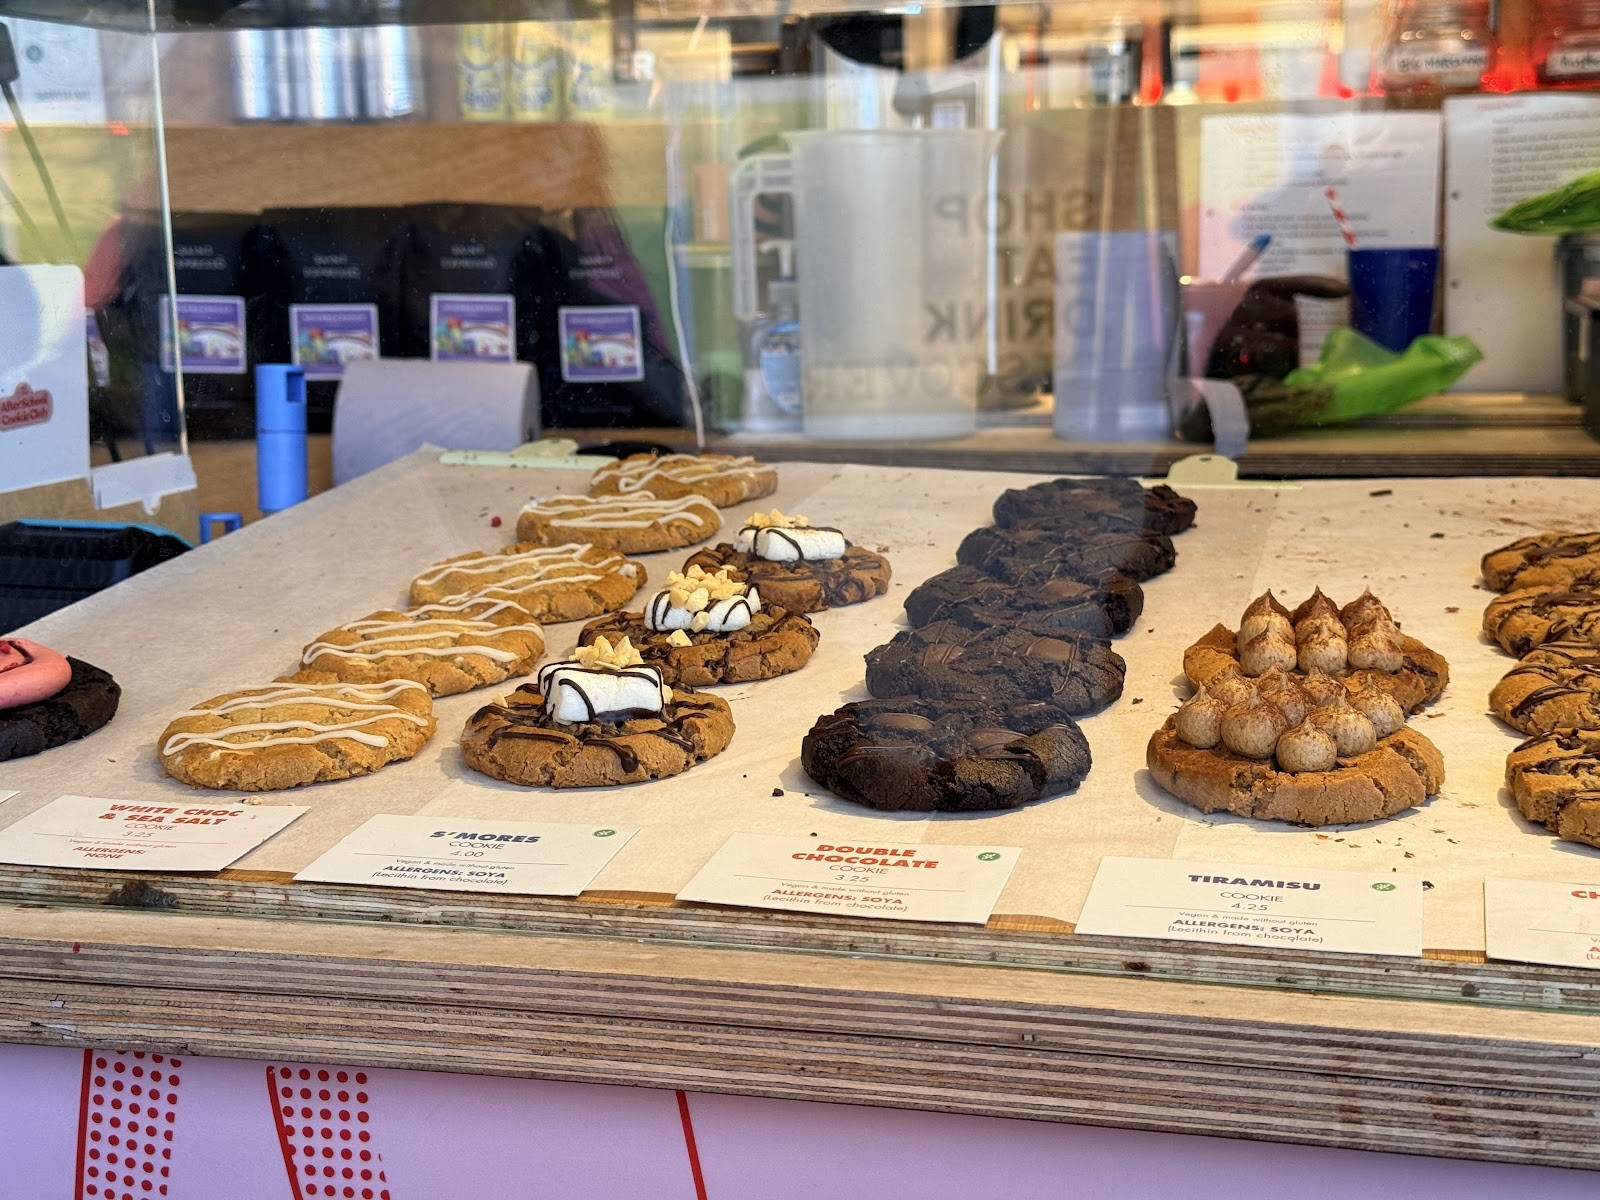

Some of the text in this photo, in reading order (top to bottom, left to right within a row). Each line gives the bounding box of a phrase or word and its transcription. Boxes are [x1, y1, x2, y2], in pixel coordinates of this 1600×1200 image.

[110, 805, 244, 817] WHITE CHOC
[123, 814, 165, 822] SEA
[171, 817, 228, 825] SALT
[430, 831, 541, 843] S'MORES
[72, 846, 147, 855] ALLERGENS:
[449, 841, 506, 850] COOKIE
[816, 844, 917, 857] DOUBLE
[450, 850, 484, 858] 4.00
[792, 853, 939, 869] CHOCOLATE
[383, 866, 506, 878] ALLERGENS: SOYA
[829, 865, 889, 875] COOKIE
[372, 871, 508, 885] (Lecithin from chocolate)
[834, 874, 870, 883] 3.25
[1188, 874, 1321, 890] TIRAMISU
[771, 889, 903, 904] ALLERGENS: SOYA
[1220, 892, 1283, 903] COOKIE
[762, 895, 908, 912] (Lecithin from chocolate)
[1230, 903, 1268, 911] 4.25
[1167, 925, 1218, 935] (Lecithin
[1223, 929, 1251, 937] from
[1173, 919, 1315, 935] ALLERGENS: SOYA
